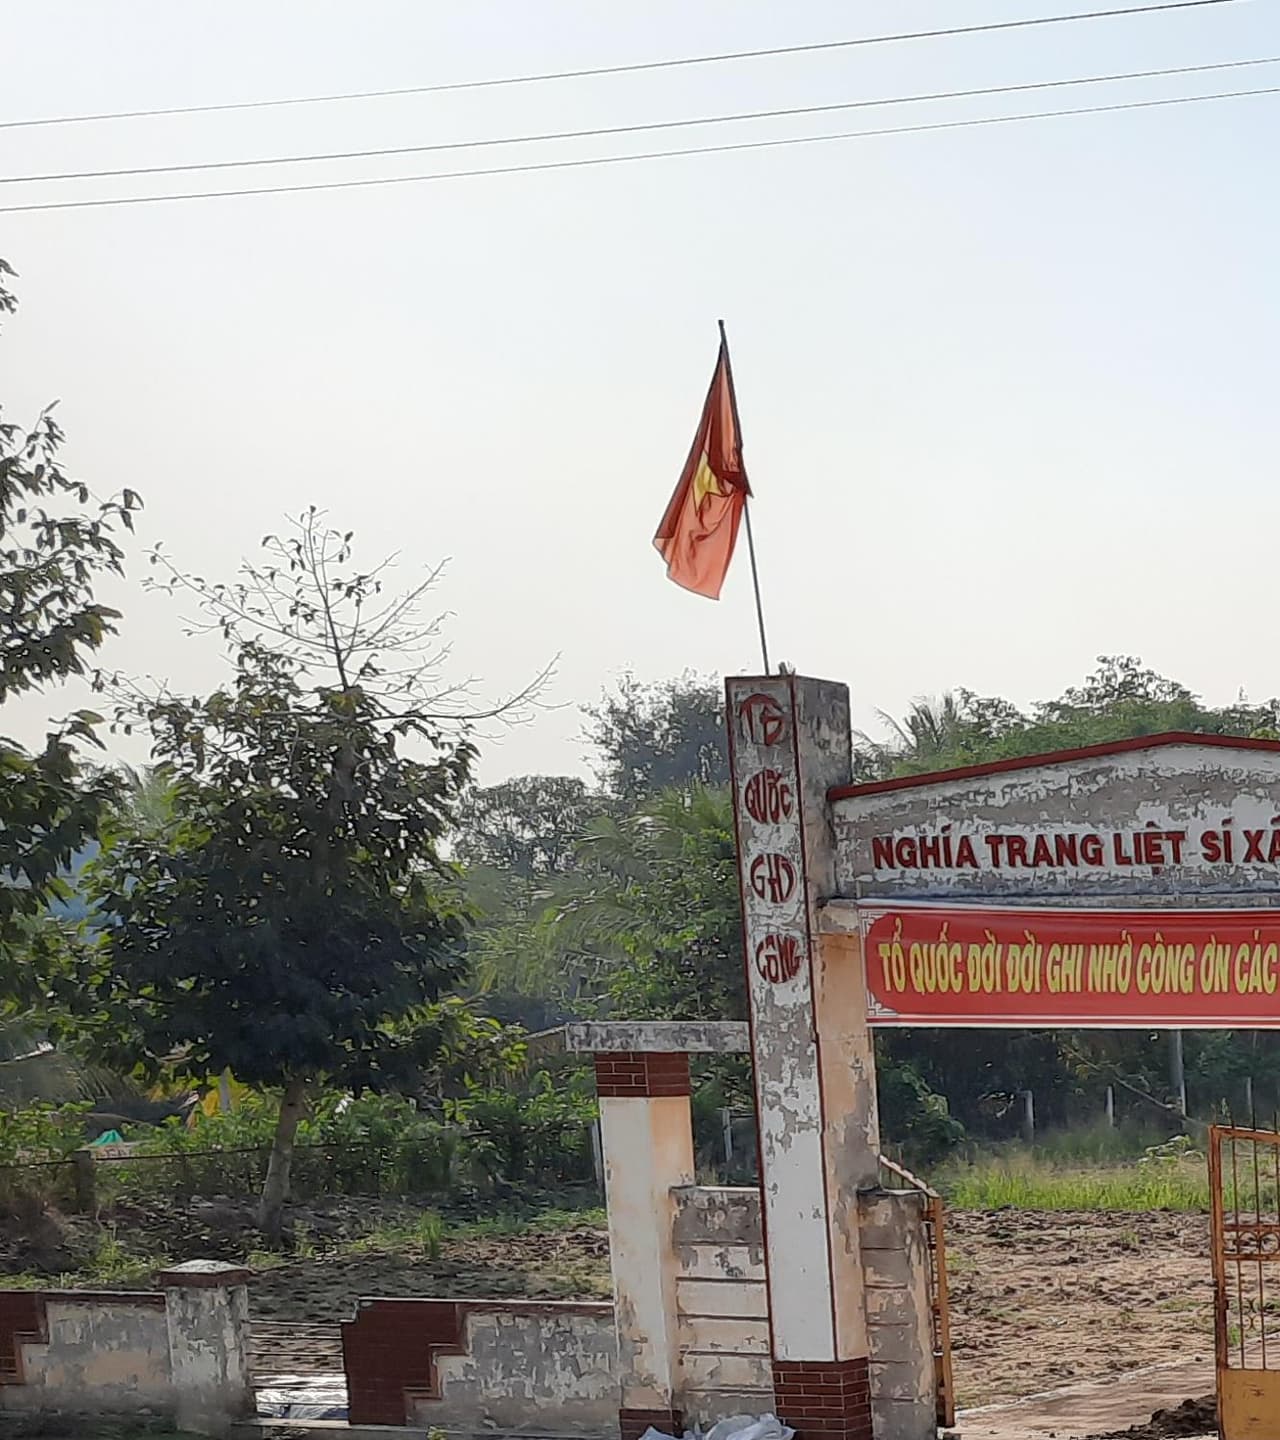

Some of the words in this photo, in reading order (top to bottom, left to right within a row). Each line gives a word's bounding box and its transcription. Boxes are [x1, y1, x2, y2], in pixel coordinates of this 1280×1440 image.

[984, 833, 1106, 869] TRANG
[1114, 820, 1186, 875] LIỆT
[878, 917, 906, 993] TỔ
[909, 921, 963, 995] QUỐC
[967, 928, 1002, 993] ĐỜI
[1007, 928, 1043, 993] ĐỜI
[1046, 943, 1084, 993] GHI
[1136, 932, 1196, 994] CÔNG
[1200, 934, 1231, 994] ƠN
[1234, 929, 1278, 994] CÁC
